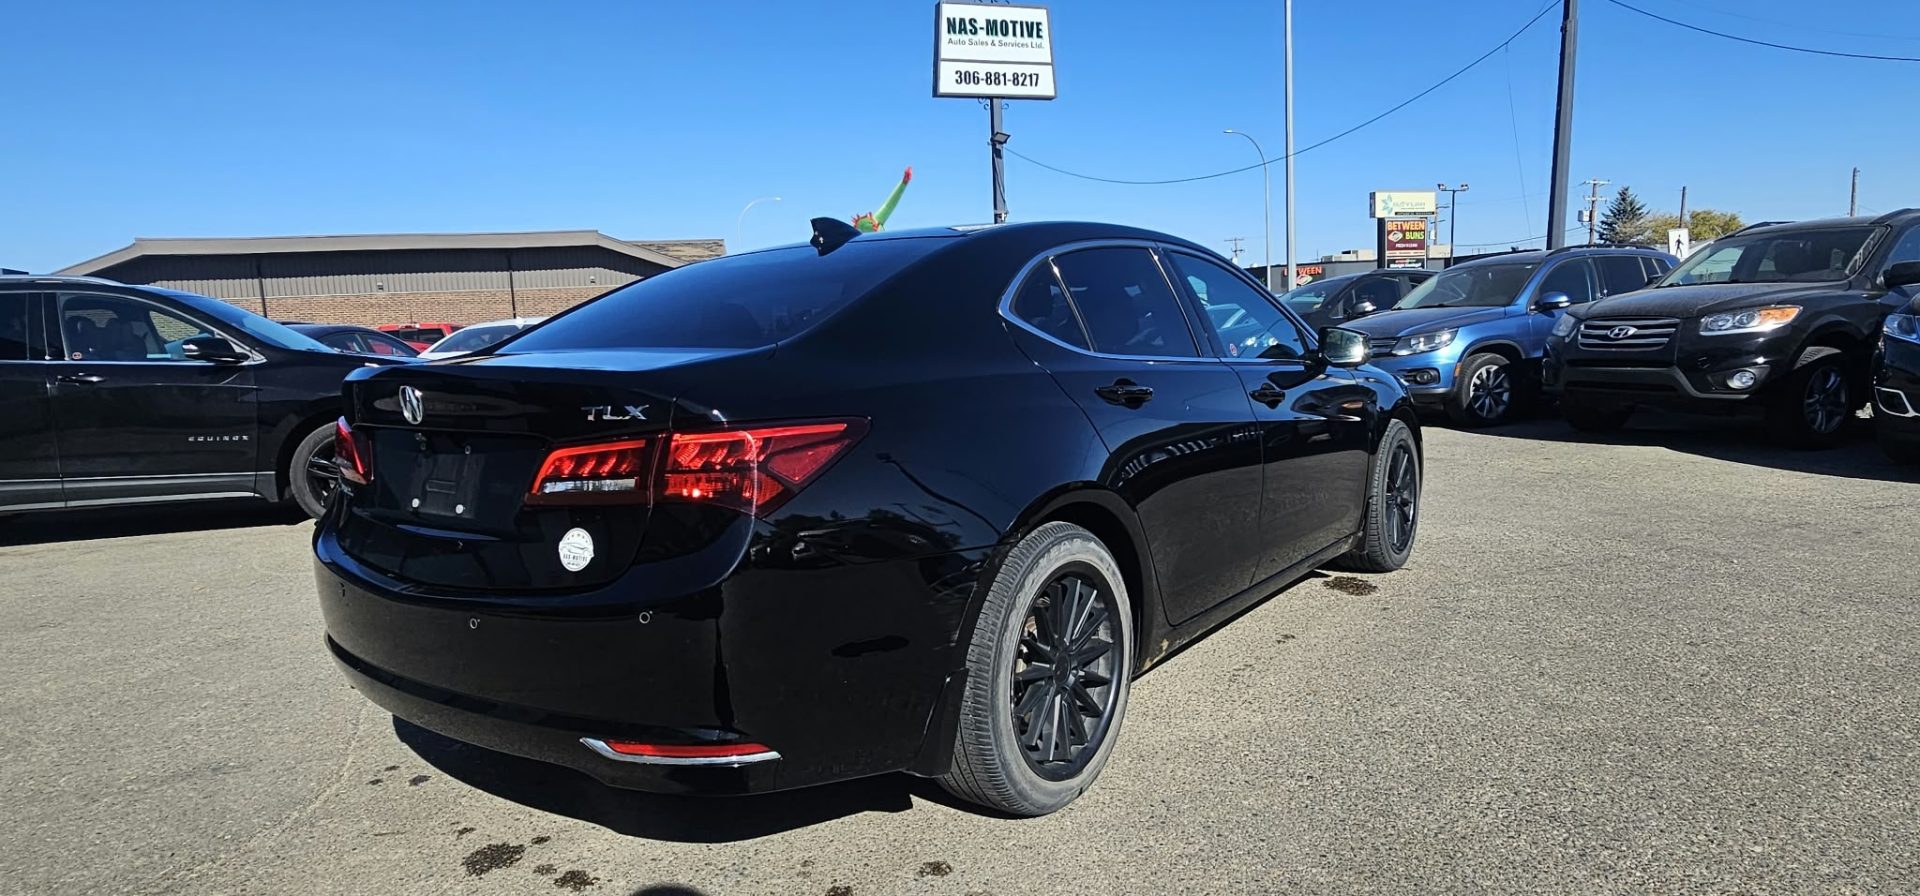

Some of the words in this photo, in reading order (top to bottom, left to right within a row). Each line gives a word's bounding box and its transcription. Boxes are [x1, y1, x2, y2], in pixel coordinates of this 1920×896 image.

[946, 17, 1043, 39] NAS-MOTIVE
[948, 38, 966, 46] Auto
[968, 39, 989, 47] Sales
[998, 40, 1029, 49] Services
[1030, 41, 1045, 49] Ltd.
[955, 70, 1040, 87] 306-881-8217
[1387, 221, 1425, 231] BETWEEN
[1405, 231, 1425, 240] BUNS
[581, 404, 650, 421] TLX
